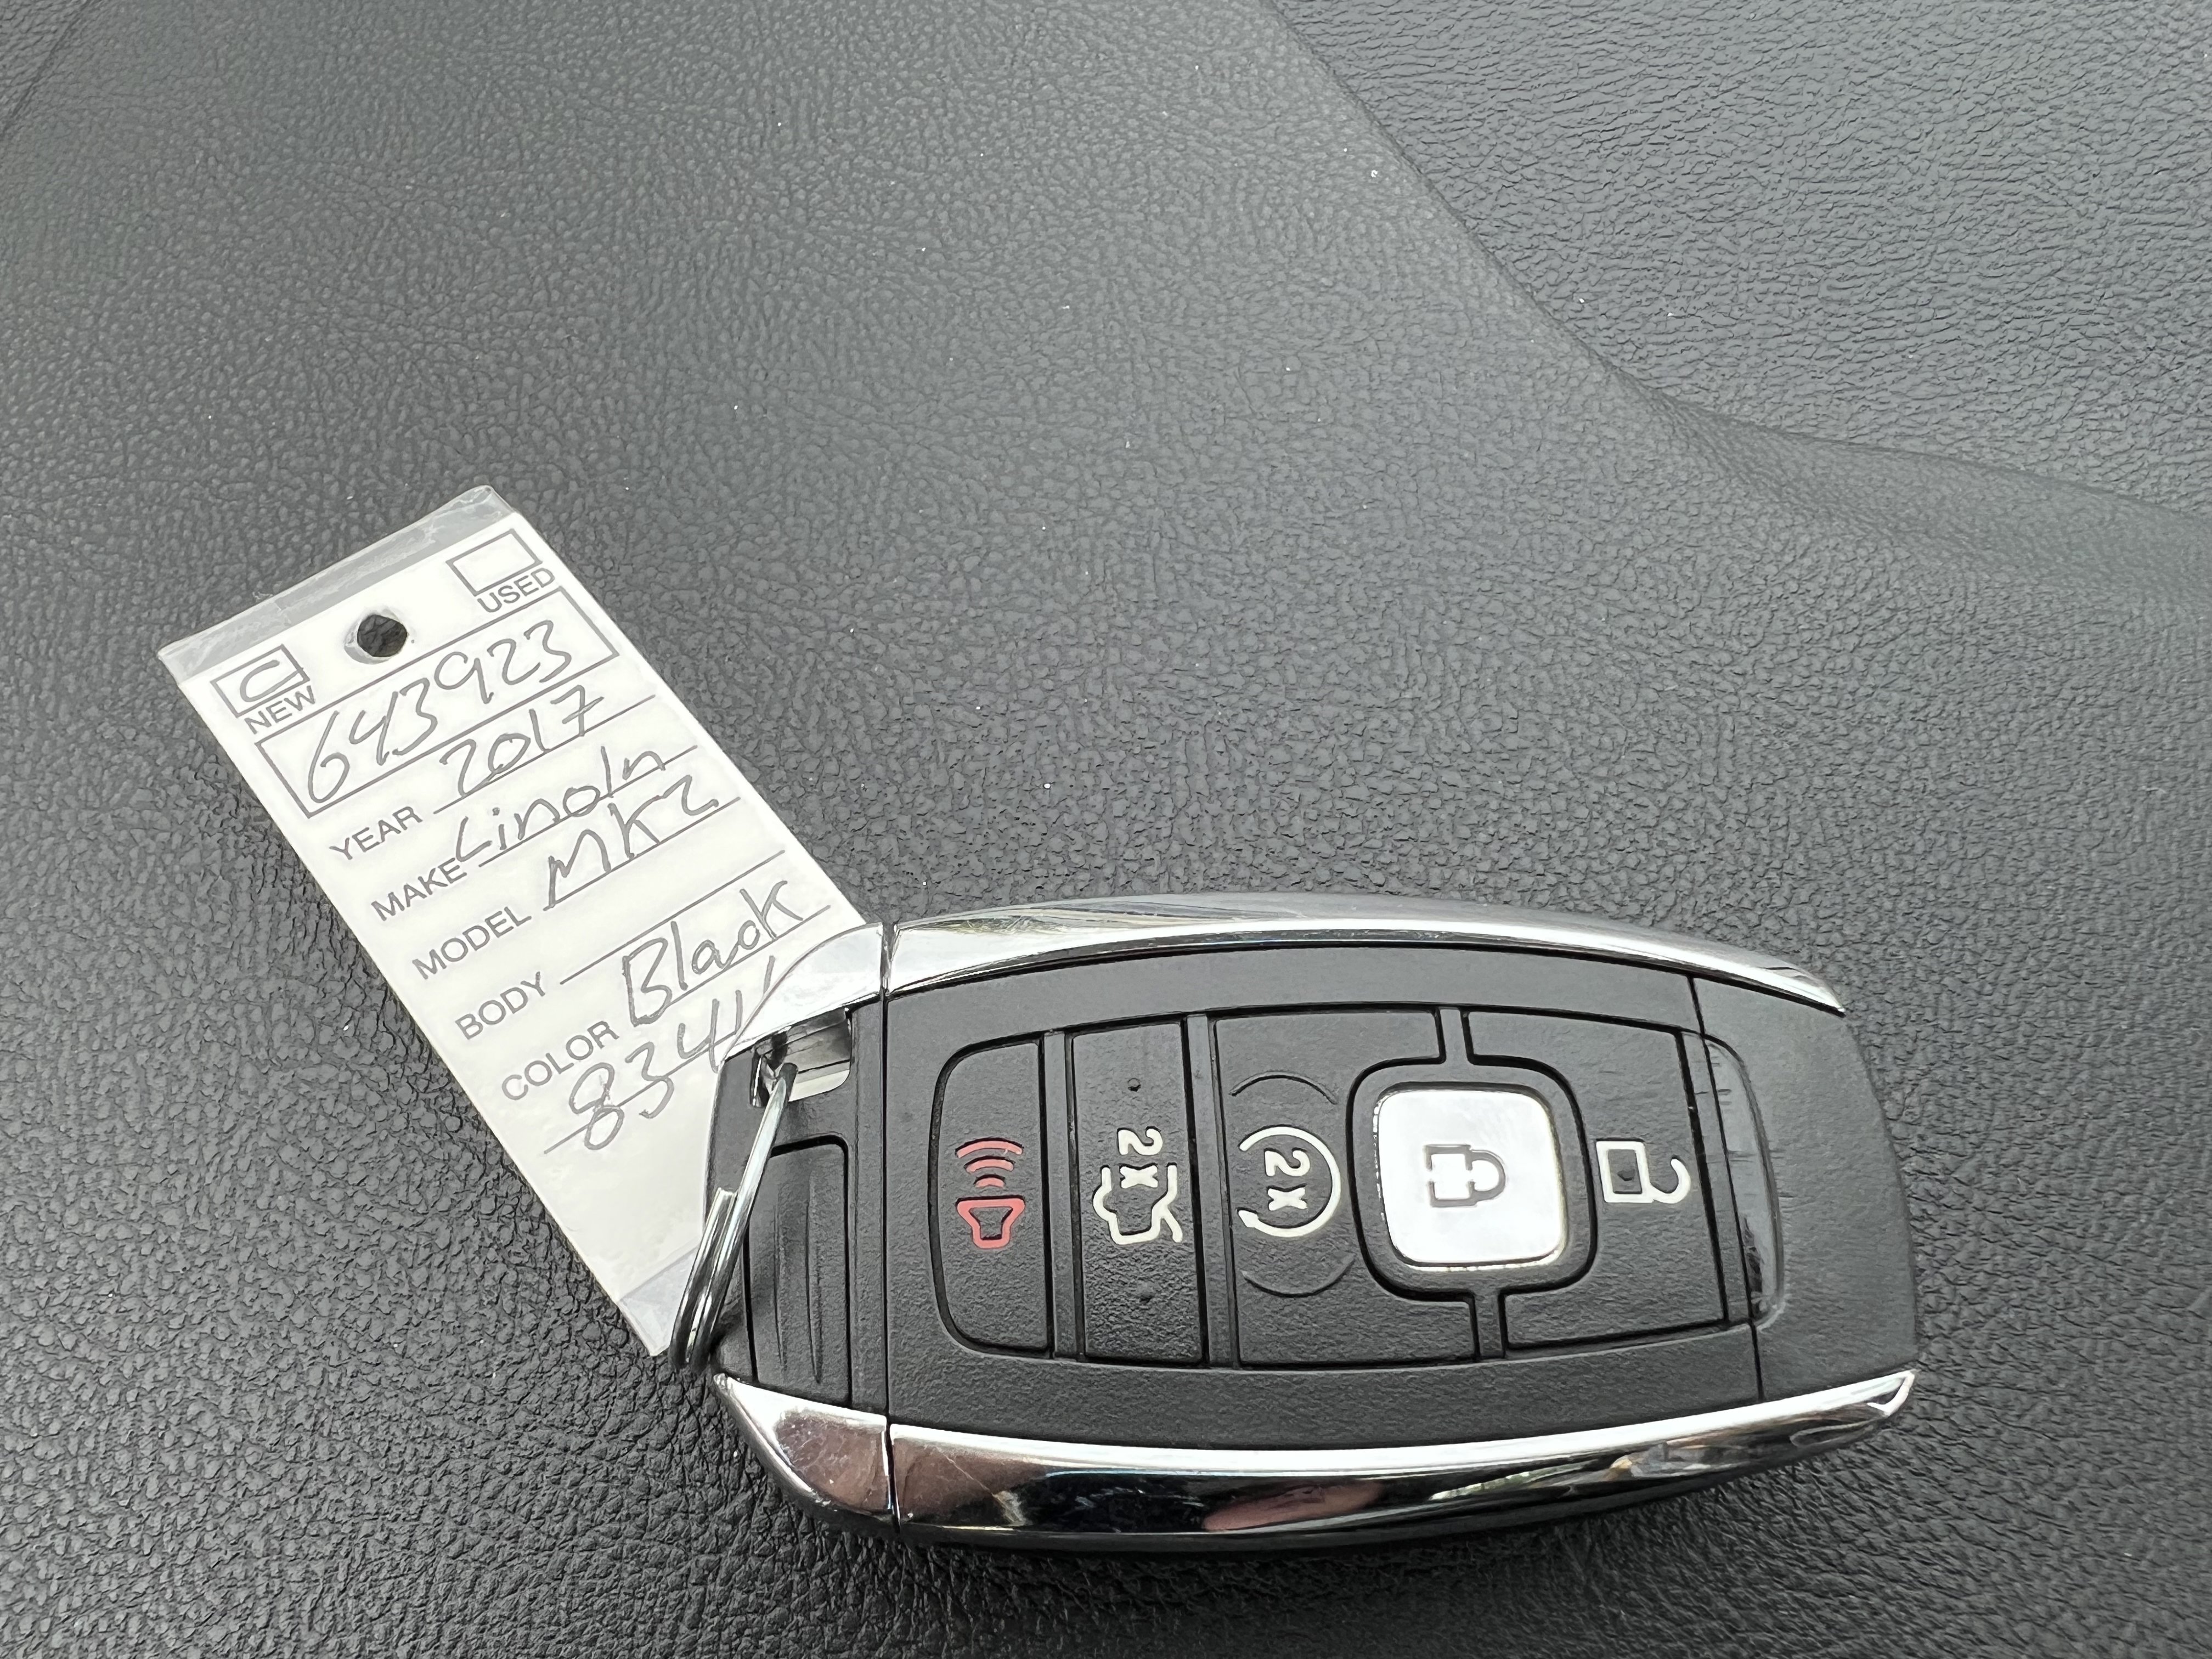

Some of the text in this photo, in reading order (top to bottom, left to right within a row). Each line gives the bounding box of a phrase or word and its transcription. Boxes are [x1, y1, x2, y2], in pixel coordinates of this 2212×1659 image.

[477, 567, 555, 613] USED
[244, 686, 315, 734] NEW
[307, 620, 572, 804] 643923
[439, 685, 605, 797] 2017
[330, 805, 423, 861] YEAR
[371, 857, 467, 922] MAKE
[412, 905, 532, 979] MODEL
[454, 971, 547, 1040] BODY
[501, 1020, 620, 1101] COLOR
